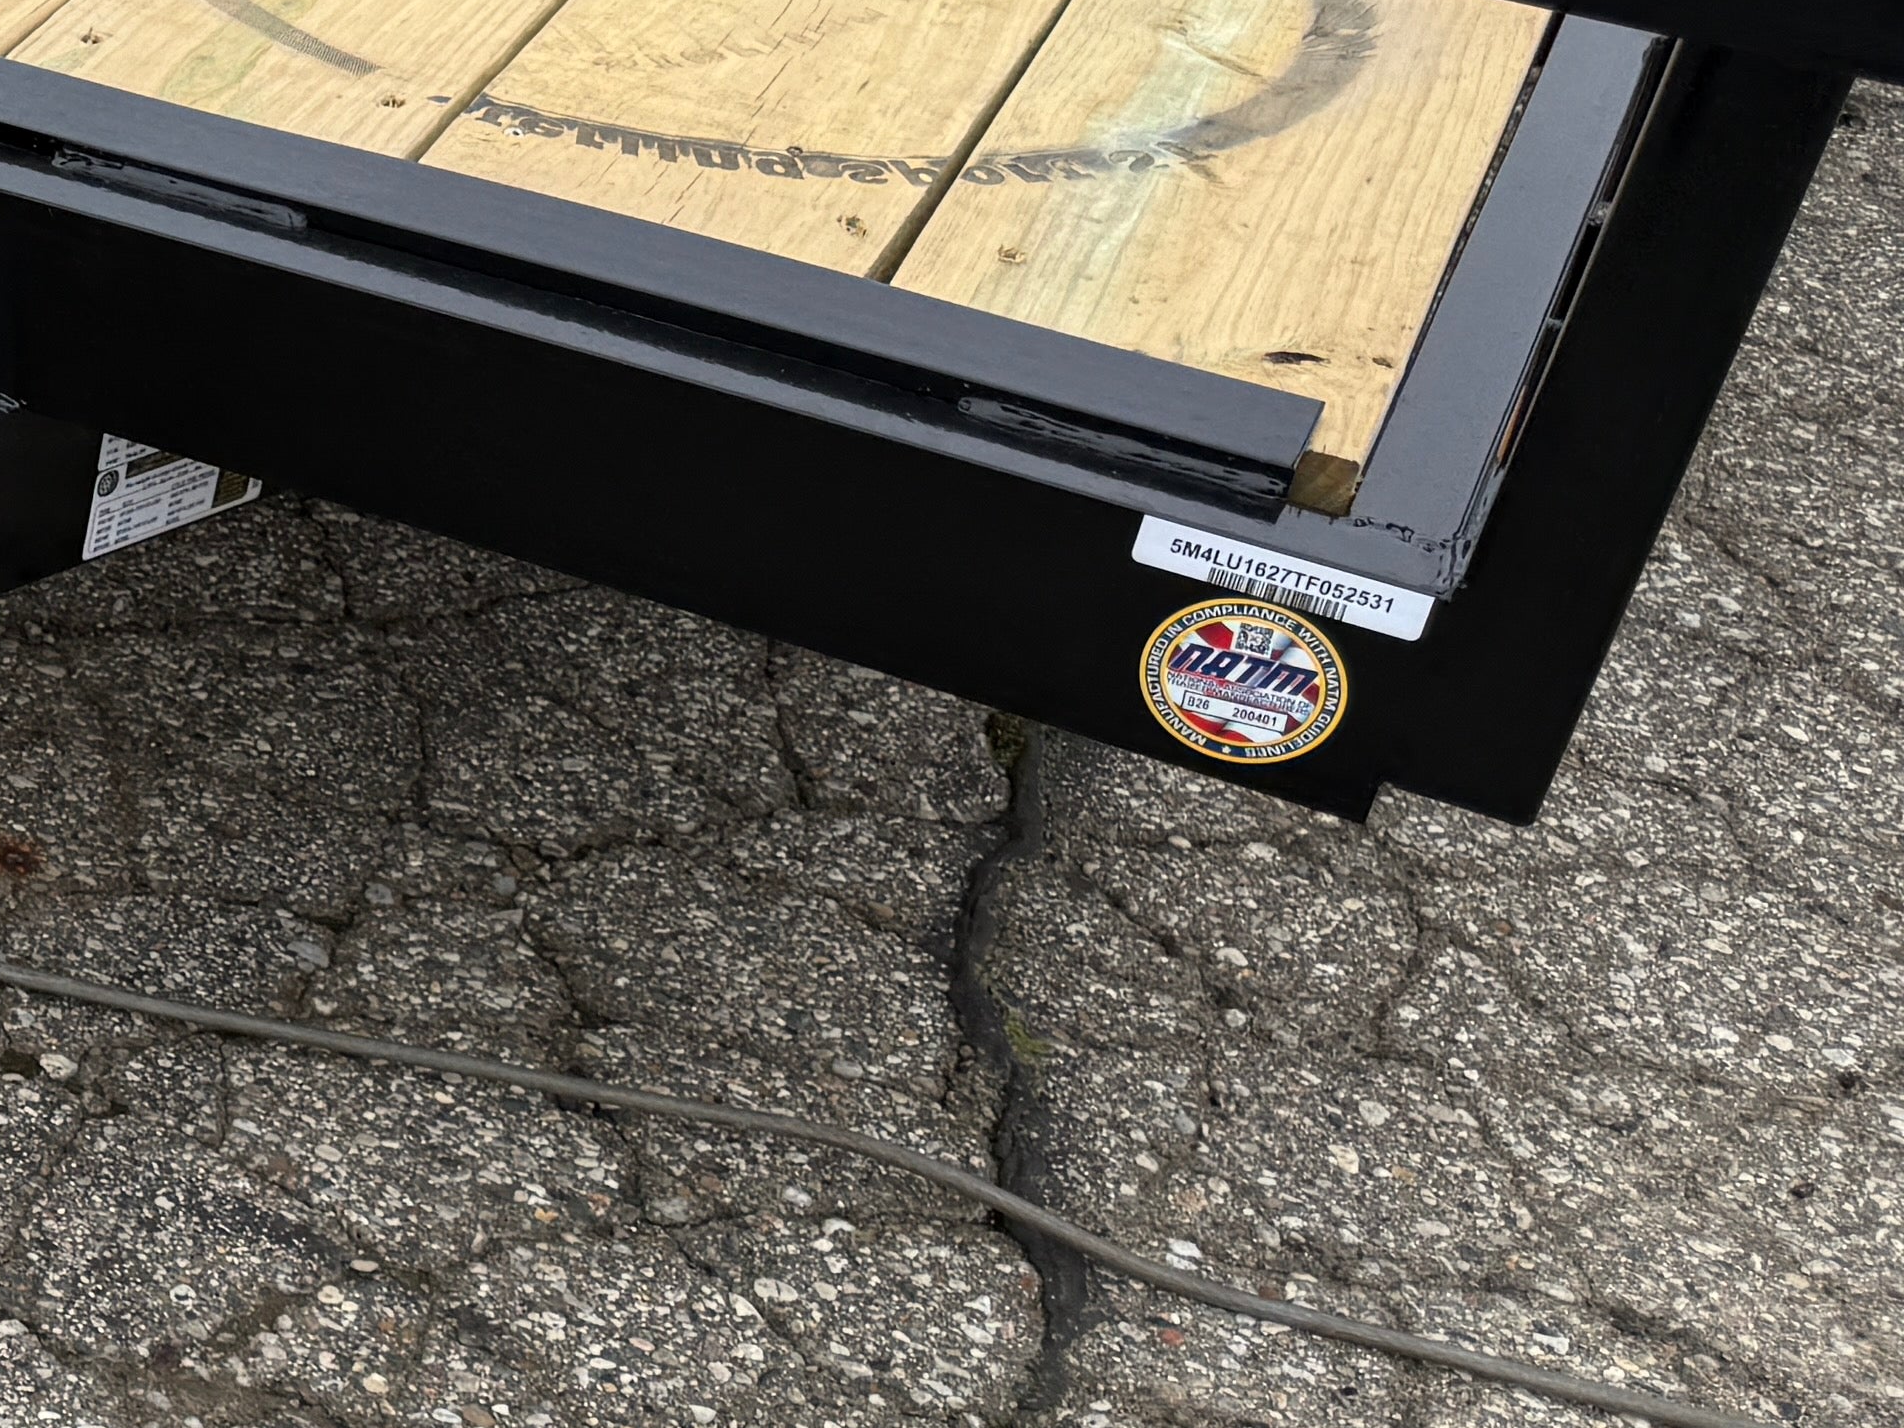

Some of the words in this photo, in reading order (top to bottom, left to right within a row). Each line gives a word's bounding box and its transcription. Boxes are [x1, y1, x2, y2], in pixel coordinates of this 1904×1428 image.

[1169, 538, 1394, 613] 5M4LU1627TF052531
[1166, 625, 1182, 640] IN
[1182, 604, 1297, 629] COMPLIANCE
[1298, 626, 1331, 664] WITH
[1147, 639, 1206, 746] MANUFACTURED
[1170, 643, 1318, 696] NATM
[1326, 664, 1339, 710] NATM
